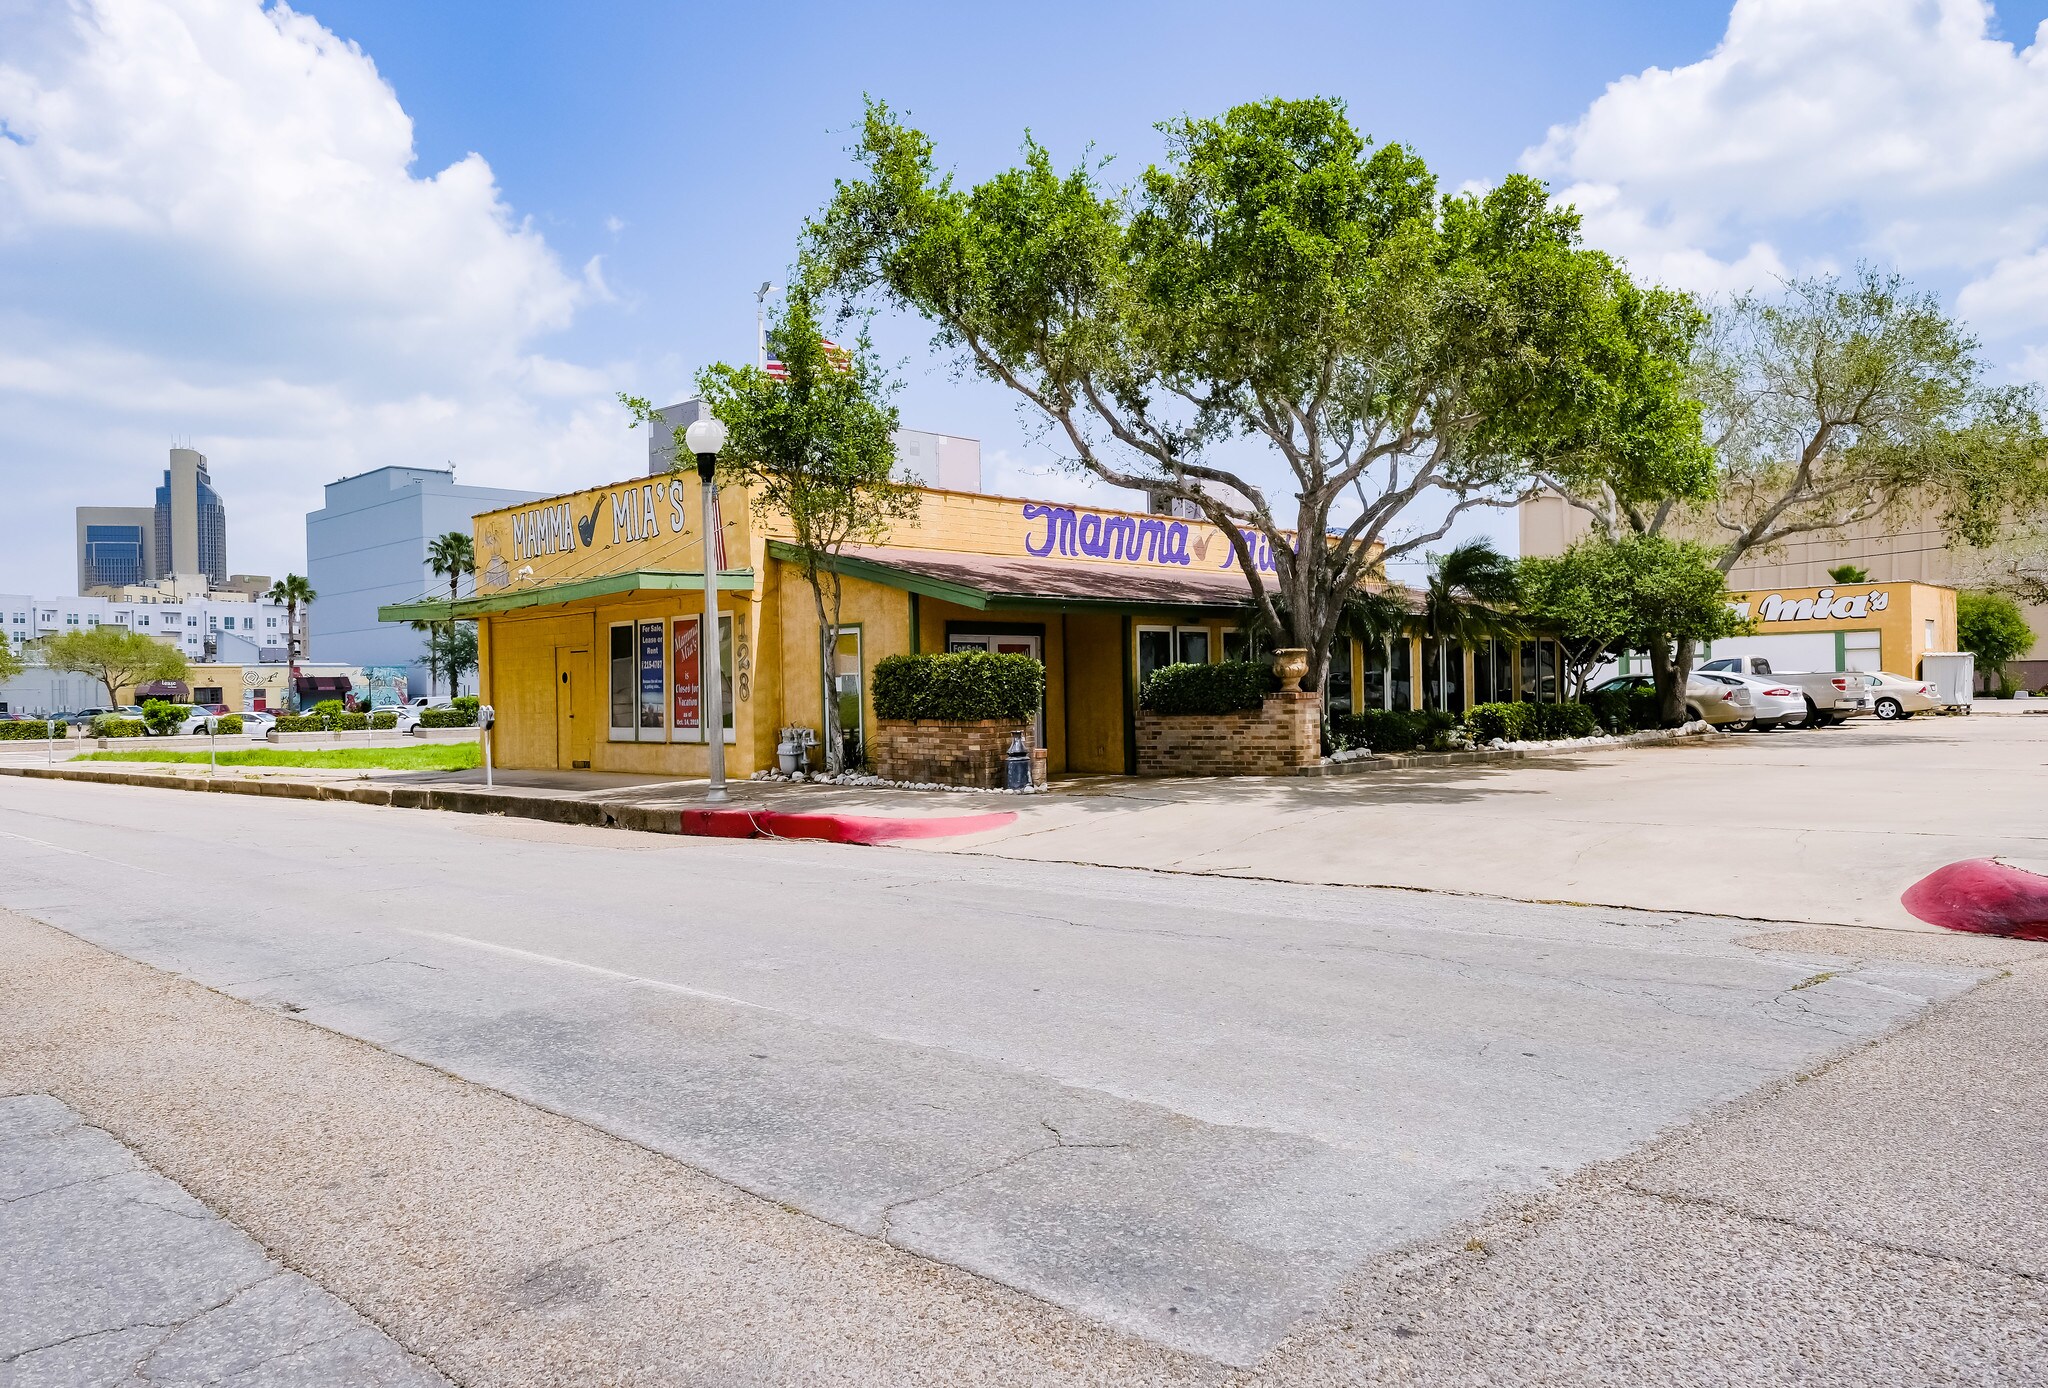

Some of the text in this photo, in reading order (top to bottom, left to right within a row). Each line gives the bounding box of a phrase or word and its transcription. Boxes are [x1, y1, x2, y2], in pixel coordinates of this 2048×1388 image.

[512, 479, 685, 561] MAMMA MIA'S
[642, 636, 657, 644] Lease
[684, 670, 689, 679] is
